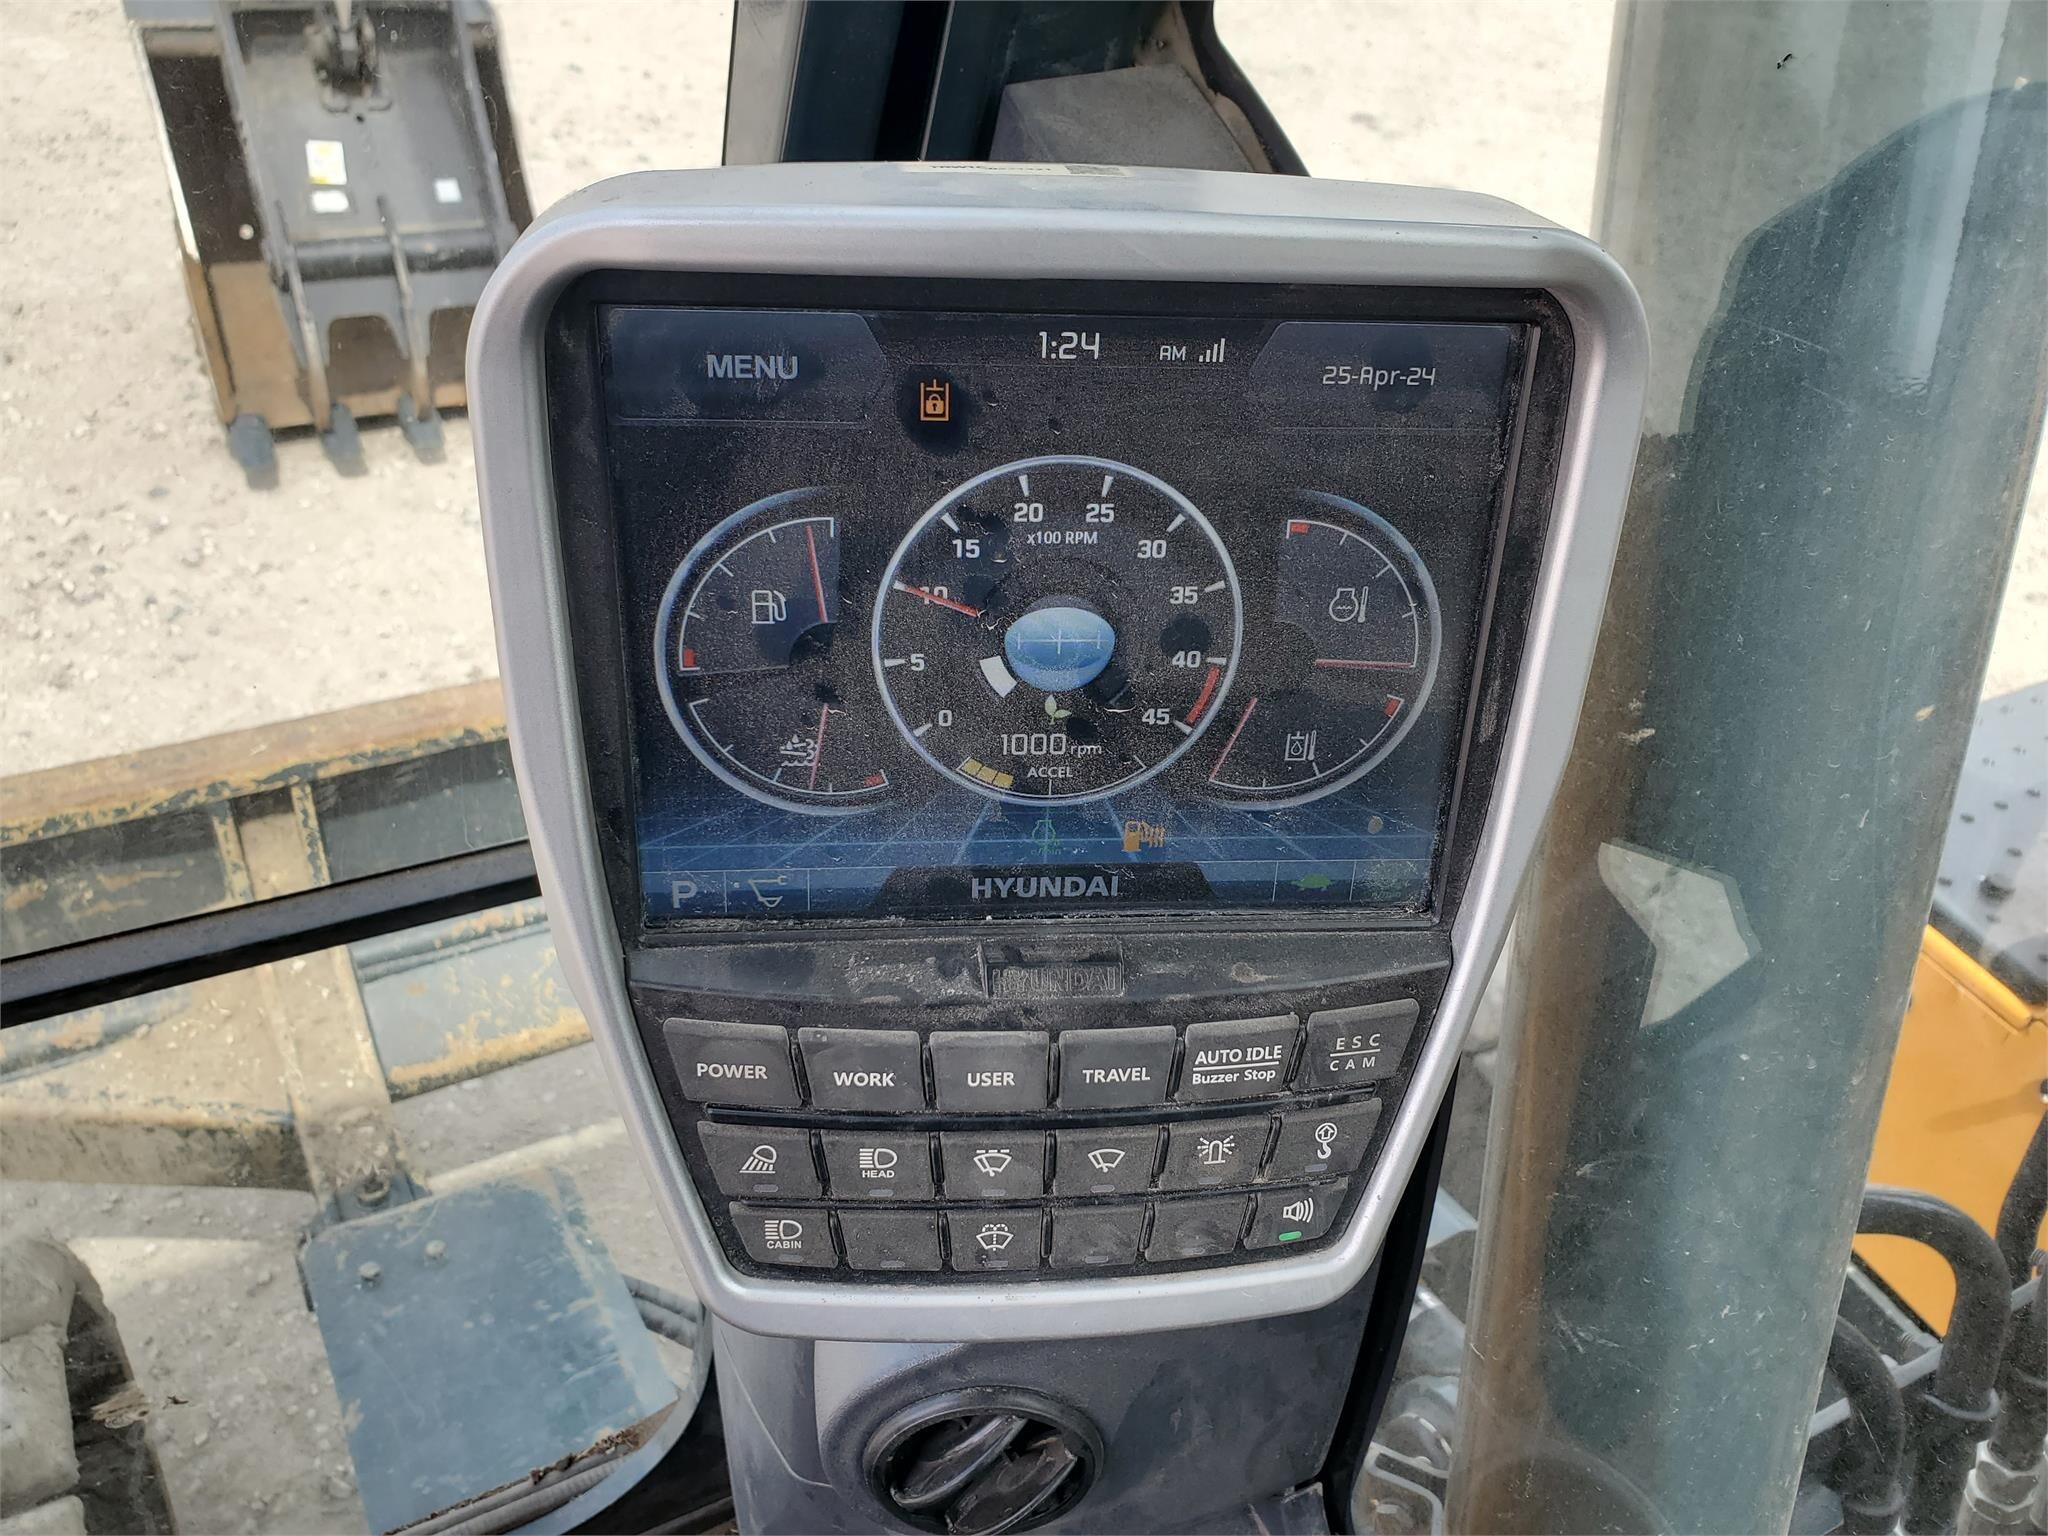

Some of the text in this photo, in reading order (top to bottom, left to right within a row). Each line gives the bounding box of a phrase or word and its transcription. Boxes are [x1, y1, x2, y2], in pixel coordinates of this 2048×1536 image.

[1038, 331, 1101, 361] 1:24
[1159, 345, 1187, 362] AM
[706, 354, 799, 380] MENU
[1322, 366, 1437, 390] 25-Apr-24
[1013, 503, 1044, 523] 20
[1085, 503, 1115, 523] 25
[1026, 531, 1099, 546] x100 RPM
[952, 539, 980, 558] 15
[1137, 540, 1167, 559] 30
[1169, 586, 1199, 605] 35
[910, 654, 925, 671] 5
[1171, 650, 1201, 669] 40
[937, 710, 953, 728] 0
[1141, 709, 1171, 727] 45
[1000, 733, 1103, 760] 1000 rpm
[1027, 766, 1074, 779] ACCEL
[672, 880, 698, 909] P
[971, 875, 1120, 899] HYUNDAI
[1194, 1045, 1283, 1065] AUTO IDLE
[696, 1063, 769, 1080] POWER
[833, 1071, 896, 1087] WORK
[967, 1072, 1015, 1087] USER
[1082, 1067, 1151, 1084] TRAVEL
[1192, 1069, 1277, 1085] Buzzer Stop
[861, 1169, 895, 1178] HEAD
[766, 1240, 802, 1249] CABIN
